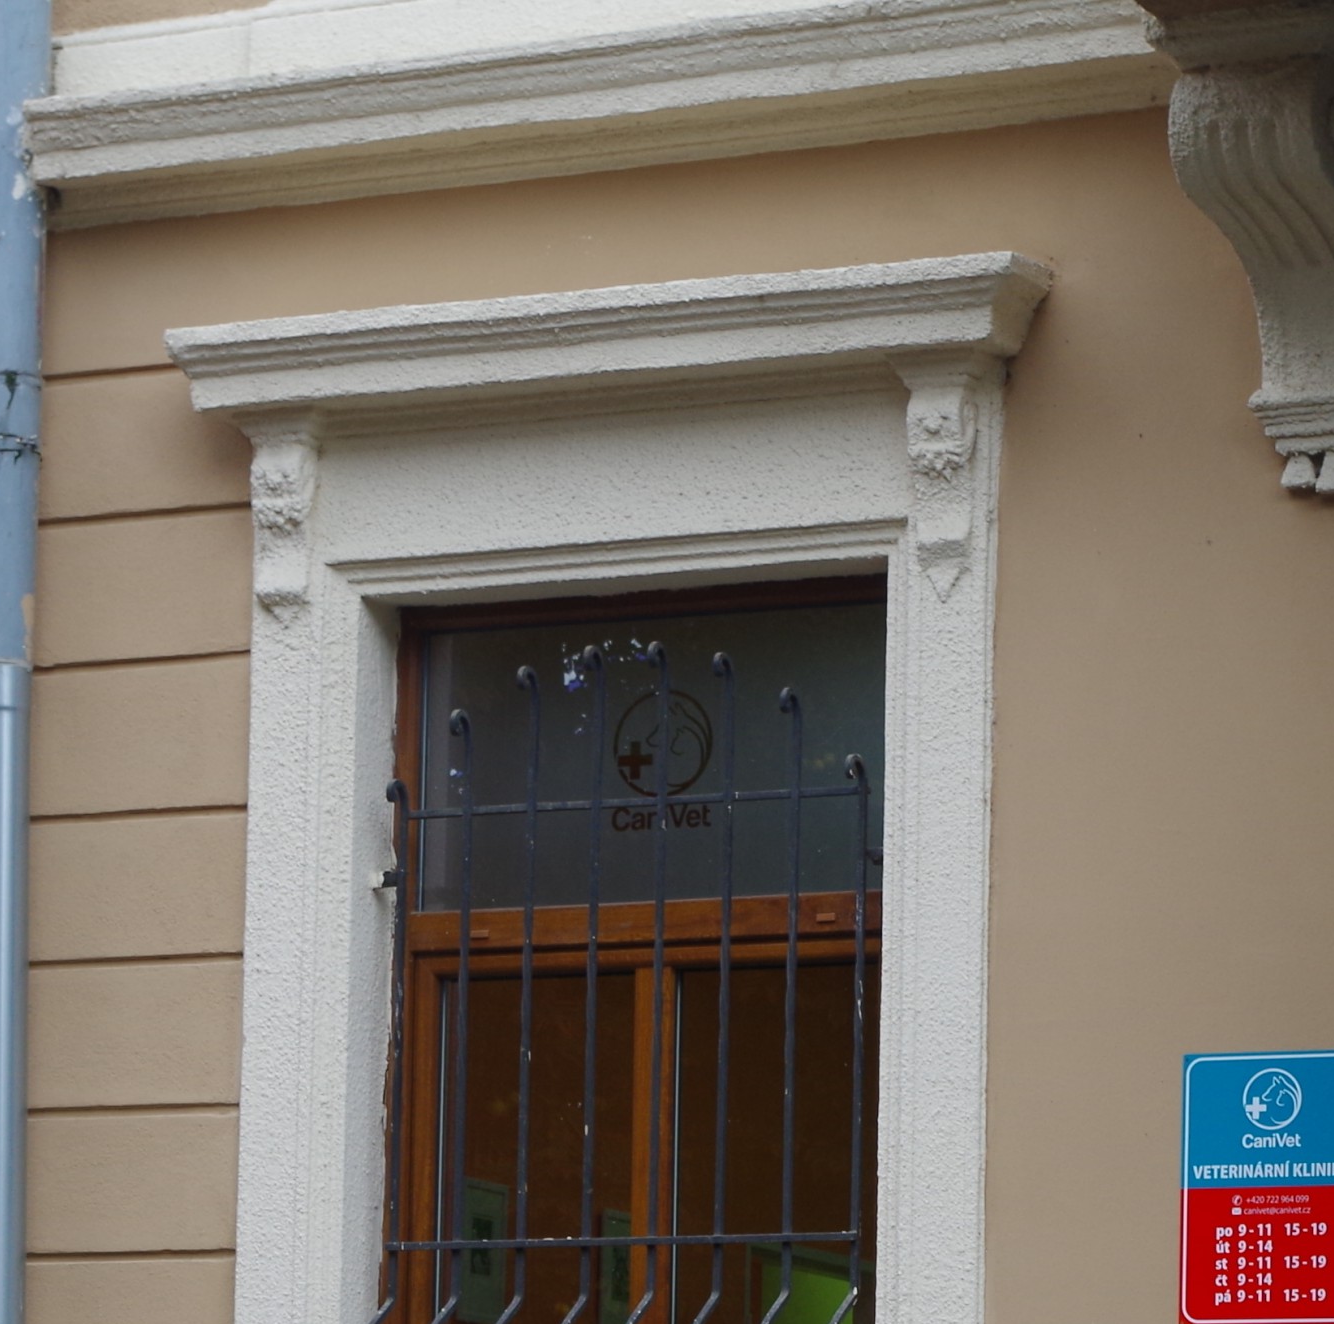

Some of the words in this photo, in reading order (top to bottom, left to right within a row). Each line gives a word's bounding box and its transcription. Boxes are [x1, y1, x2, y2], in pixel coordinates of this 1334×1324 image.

[611, 803, 711, 832] CanVet
[1242, 1132, 1301, 1149] CaniVet
[1193, 1160, 1289, 1179] VETERINÁRNÍ
[1243, 1206, 1311, 1215] canivet@canivet.cz
[1216, 1227, 1233, 1240] po
[1238, 1224, 1247, 1237] 9
[1257, 1223, 1271, 1236] 11
[1284, 1223, 1300, 1236] 15
[1311, 1222, 1327, 1235] 19
[1216, 1240, 1230, 1254] út
[1238, 1240, 1246, 1253] 9
[1257, 1240, 1273, 1253] 14
[1215, 1258, 1228, 1270] st
[1237, 1257, 1246, 1270] 9
[1256, 1256, 1271, 1269] 11
[1284, 1256, 1300, 1269] 15
[1310, 1255, 1327, 1268] 19
[1215, 1274, 1228, 1286] čt
[1237, 1273, 1246, 1286] 9
[1256, 1273, 1272, 1286] 14
[1215, 1289, 1232, 1306] pá
[1237, 1289, 1246, 1303] 9
[1256, 1289, 1271, 1302] 11
[1283, 1289, 1299, 1302] 15
[1310, 1288, 1326, 1301] 19
